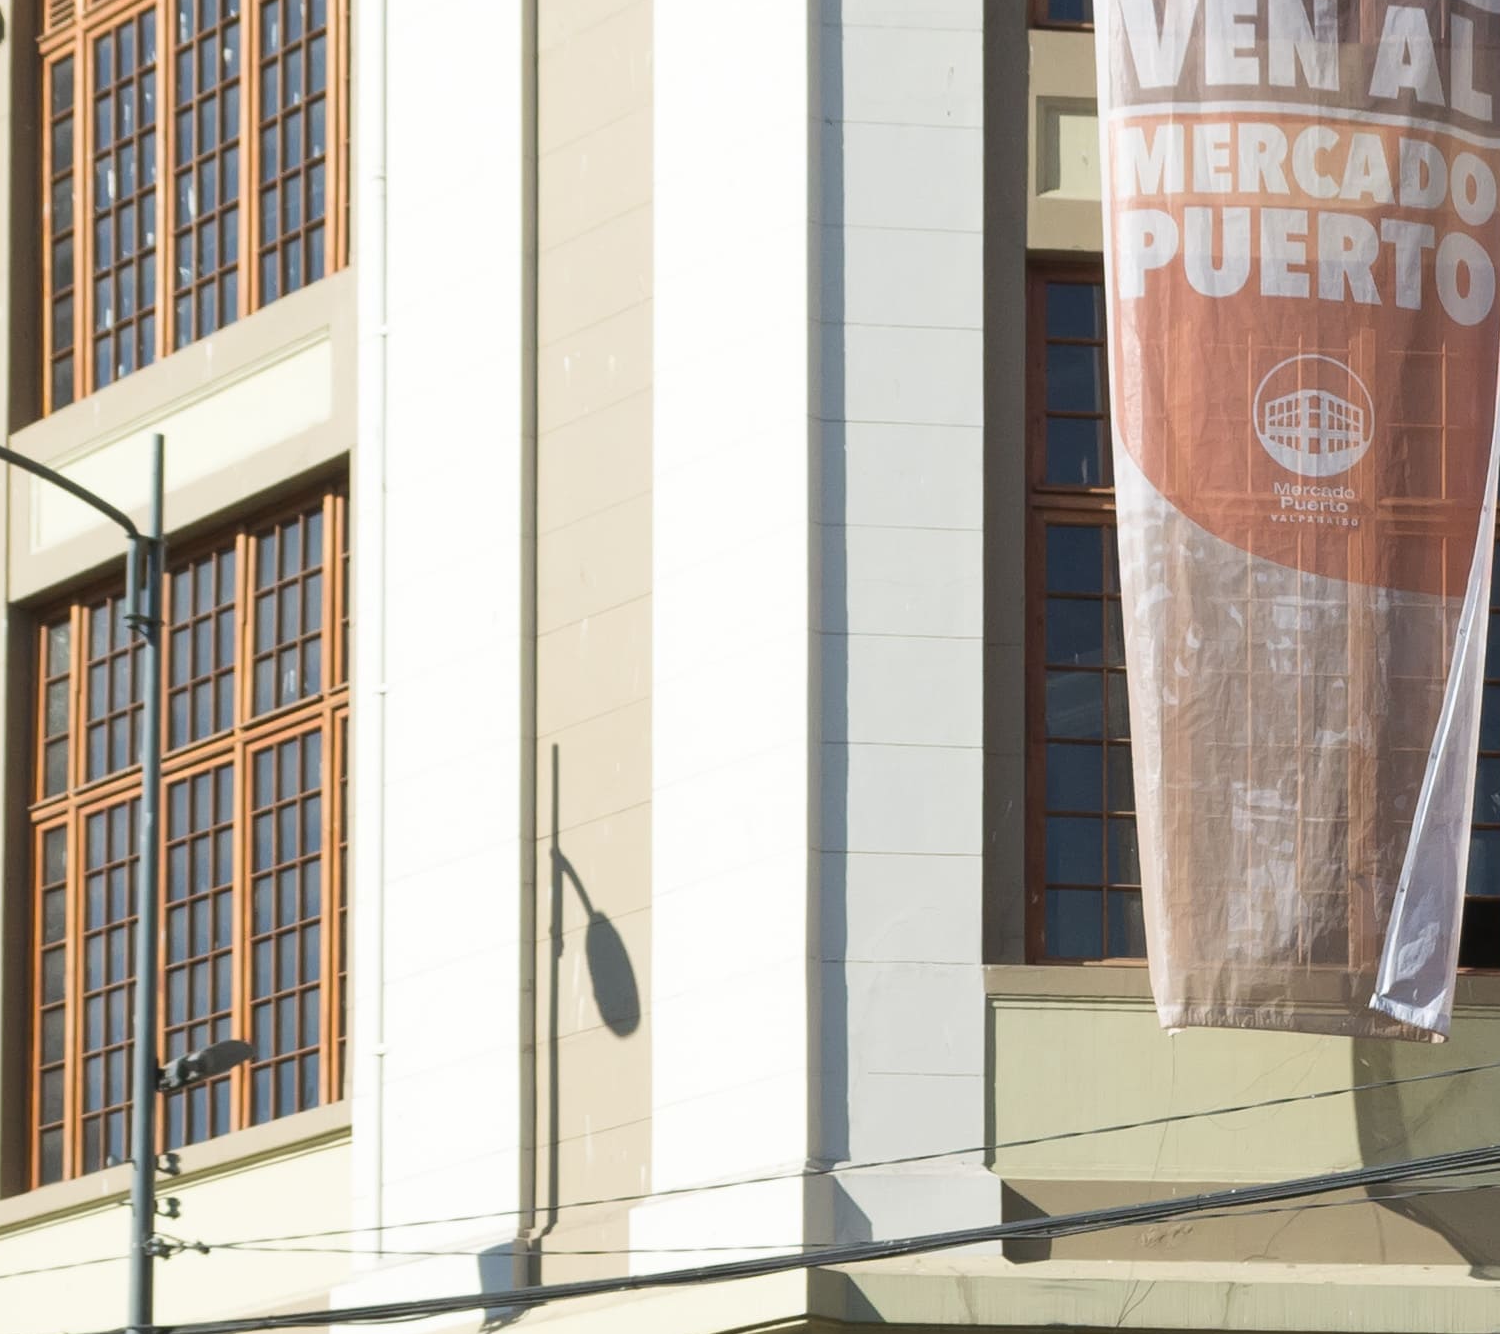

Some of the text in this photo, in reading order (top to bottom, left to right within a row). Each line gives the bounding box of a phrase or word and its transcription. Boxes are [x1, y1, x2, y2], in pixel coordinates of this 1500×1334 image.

[1369, 6, 1493, 121] AL
[1115, 123, 1497, 227] MERCADO
[1117, 207, 1497, 327] PUERTO
[1273, 482, 1355, 499] Mercado
[1280, 496, 1348, 513] Puerto
